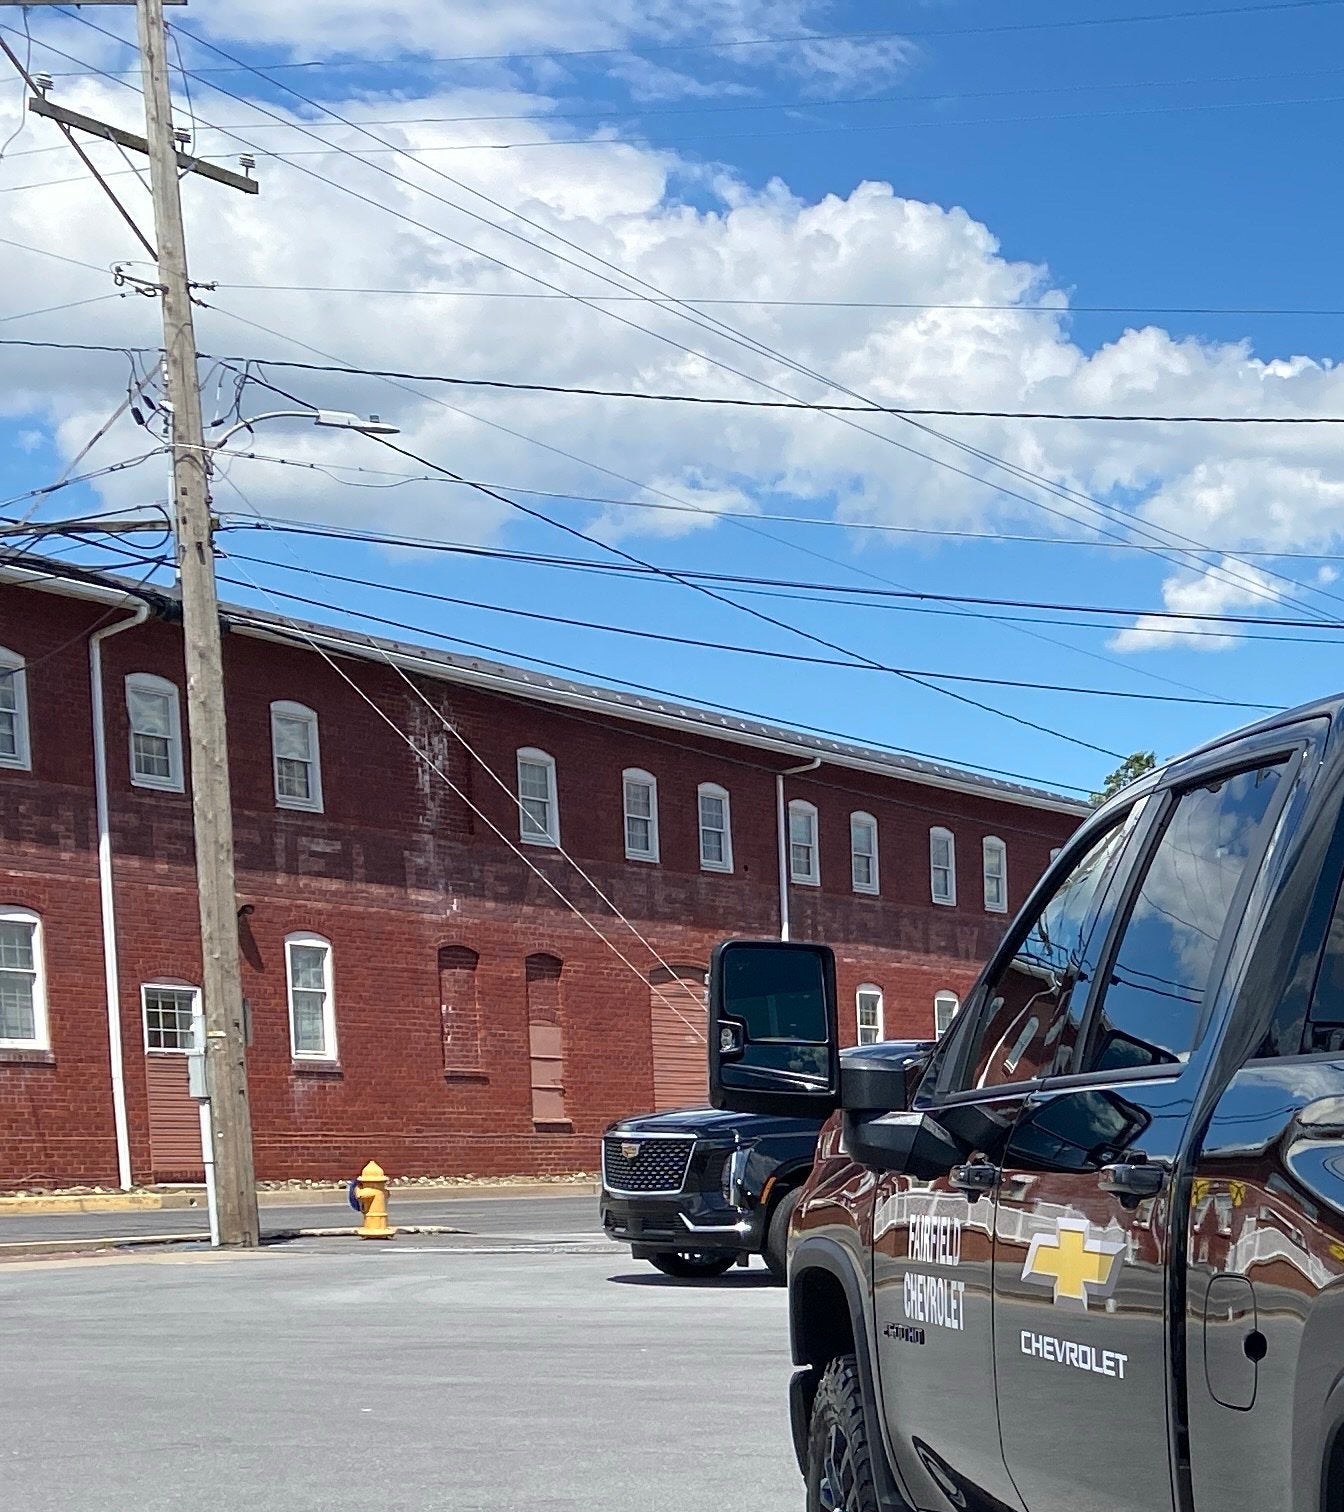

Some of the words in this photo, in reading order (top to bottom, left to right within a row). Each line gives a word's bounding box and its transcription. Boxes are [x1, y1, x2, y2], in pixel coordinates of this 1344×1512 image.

[908, 1214, 961, 1267] FAIRFIELD
[903, 1272, 965, 1331] CHEVROLET
[1021, 1330, 1128, 1379] CHEVROLET
